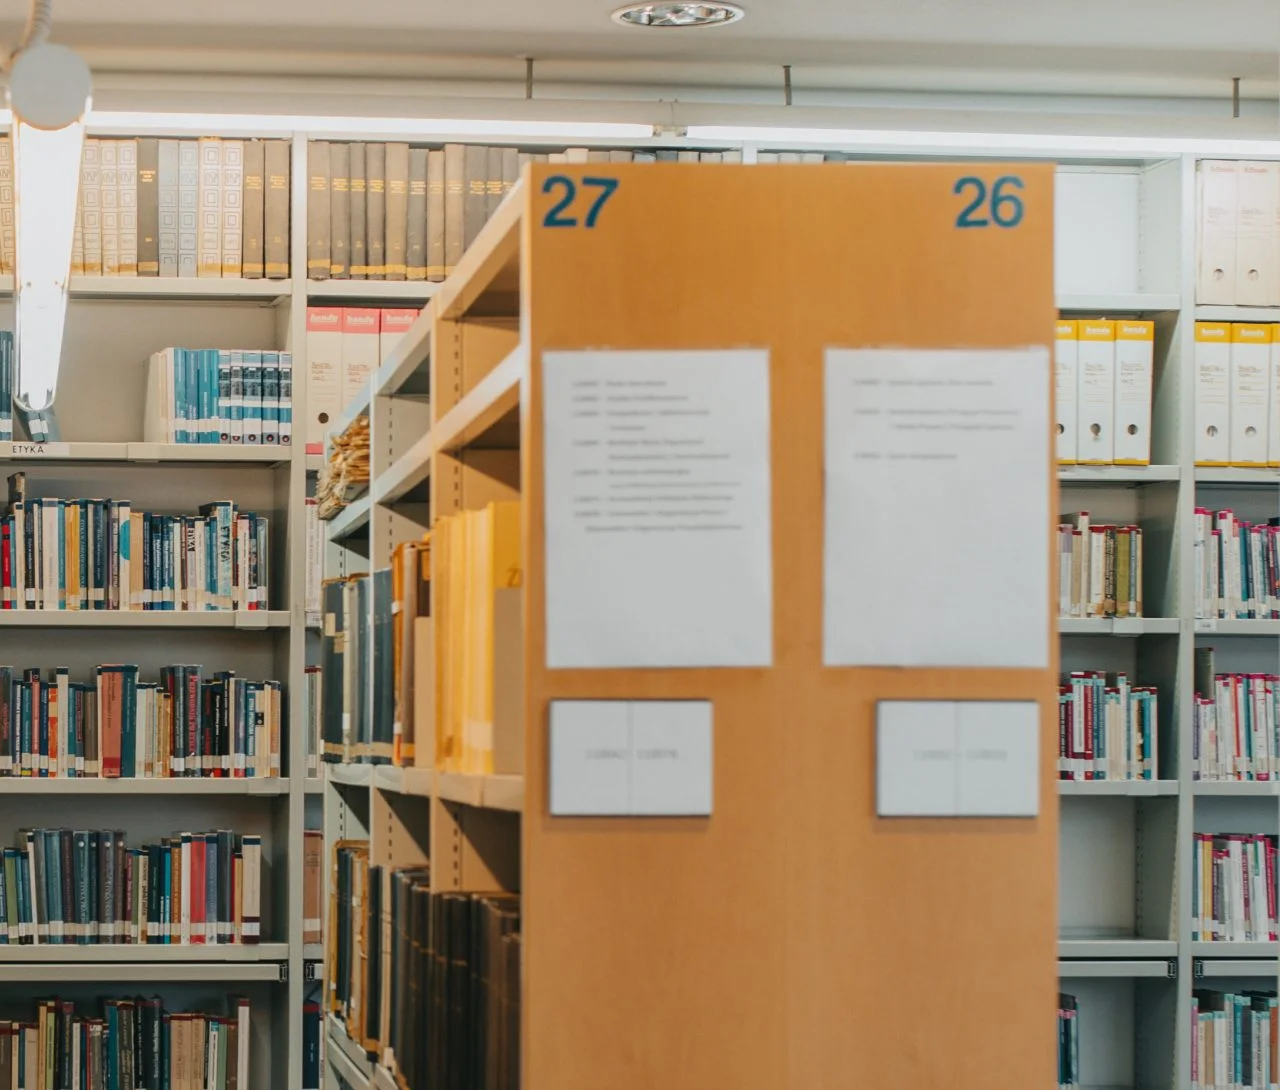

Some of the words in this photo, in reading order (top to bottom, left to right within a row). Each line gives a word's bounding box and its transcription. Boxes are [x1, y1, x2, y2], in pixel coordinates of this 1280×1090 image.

[542, 175, 618, 228] 27
[953, 176, 1024, 228] 26
[12, 445, 45, 454] ETYKA
[187, 527, 195, 550] ETYKA
[220, 526, 230, 563] ETYKA
